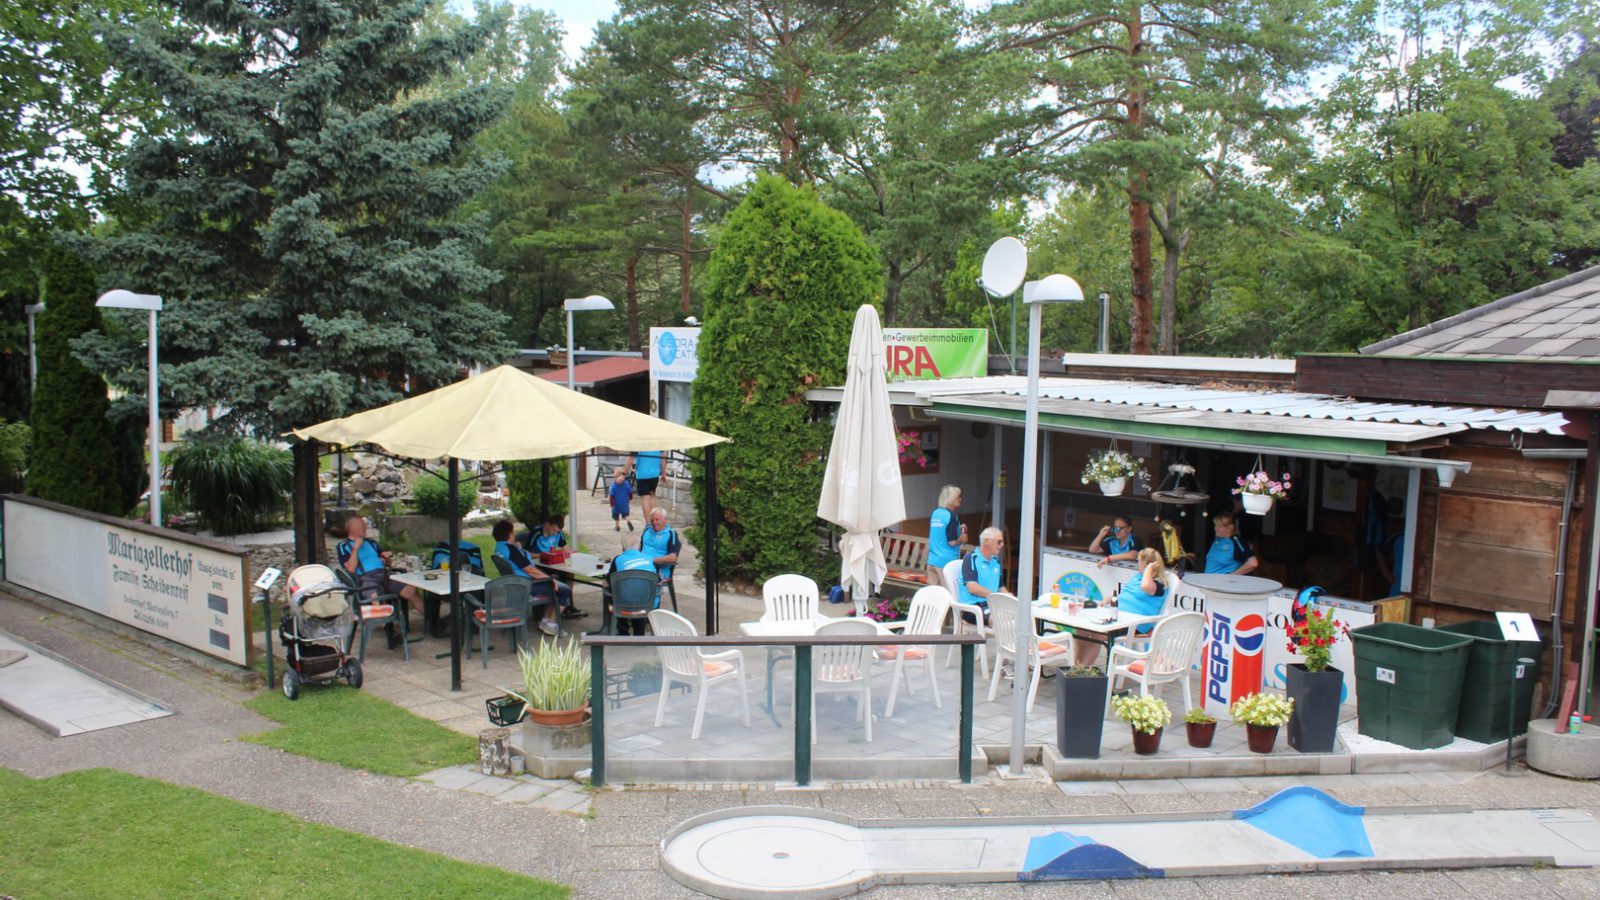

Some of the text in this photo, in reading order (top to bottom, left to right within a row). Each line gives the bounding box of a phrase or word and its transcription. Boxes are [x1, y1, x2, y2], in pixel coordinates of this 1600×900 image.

[107, 531, 192, 583] Mariazellerhof
[261, 572, 272, 584] 2
[1509, 620, 1520, 632] 1
[1208, 611, 1231, 704] PEPSI
